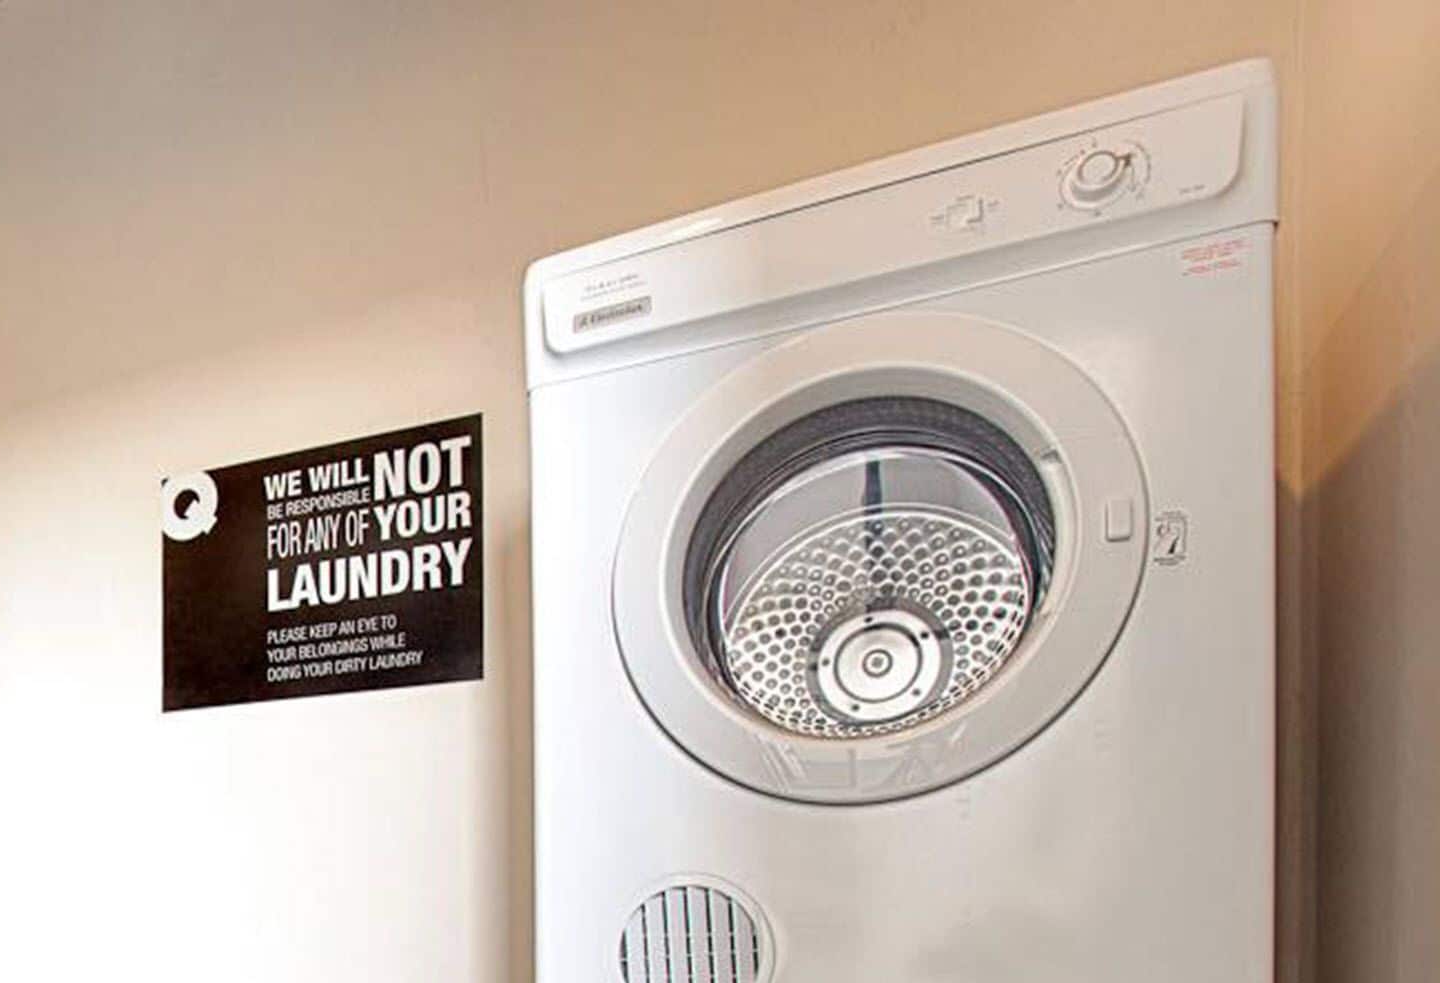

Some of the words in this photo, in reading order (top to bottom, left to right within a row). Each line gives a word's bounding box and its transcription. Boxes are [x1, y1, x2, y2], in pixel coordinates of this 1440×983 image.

[264, 471, 302, 501] WE
[308, 458, 370, 492] WILL
[374, 436, 472, 500] NOT
[161, 471, 218, 540] Q
[267, 503, 284, 520] BE
[286, 487, 371, 516] RESPONSIBLE
[267, 521, 301, 560] FOR
[304, 514, 341, 554] ANY
[345, 509, 369, 547] OF
[373, 491, 472, 541] YOUR
[267, 538, 473, 613] LAUNDRY
[267, 626, 307, 645] PLEASE
[310, 622, 338, 639] KEEP
[339, 621, 356, 635] AN
[357, 618, 378, 634] EYE
[381, 614, 397, 630] TO
[267, 646, 297, 664] YOUR
[298, 638, 369, 660] BELONGINGS
[370, 632, 406, 650] WHILE
[267, 664, 301, 683] DOING
[303, 661, 333, 678] YOUR
[334, 656, 367, 675] DIRTY
[369, 651, 425, 671] LAUNDRY
